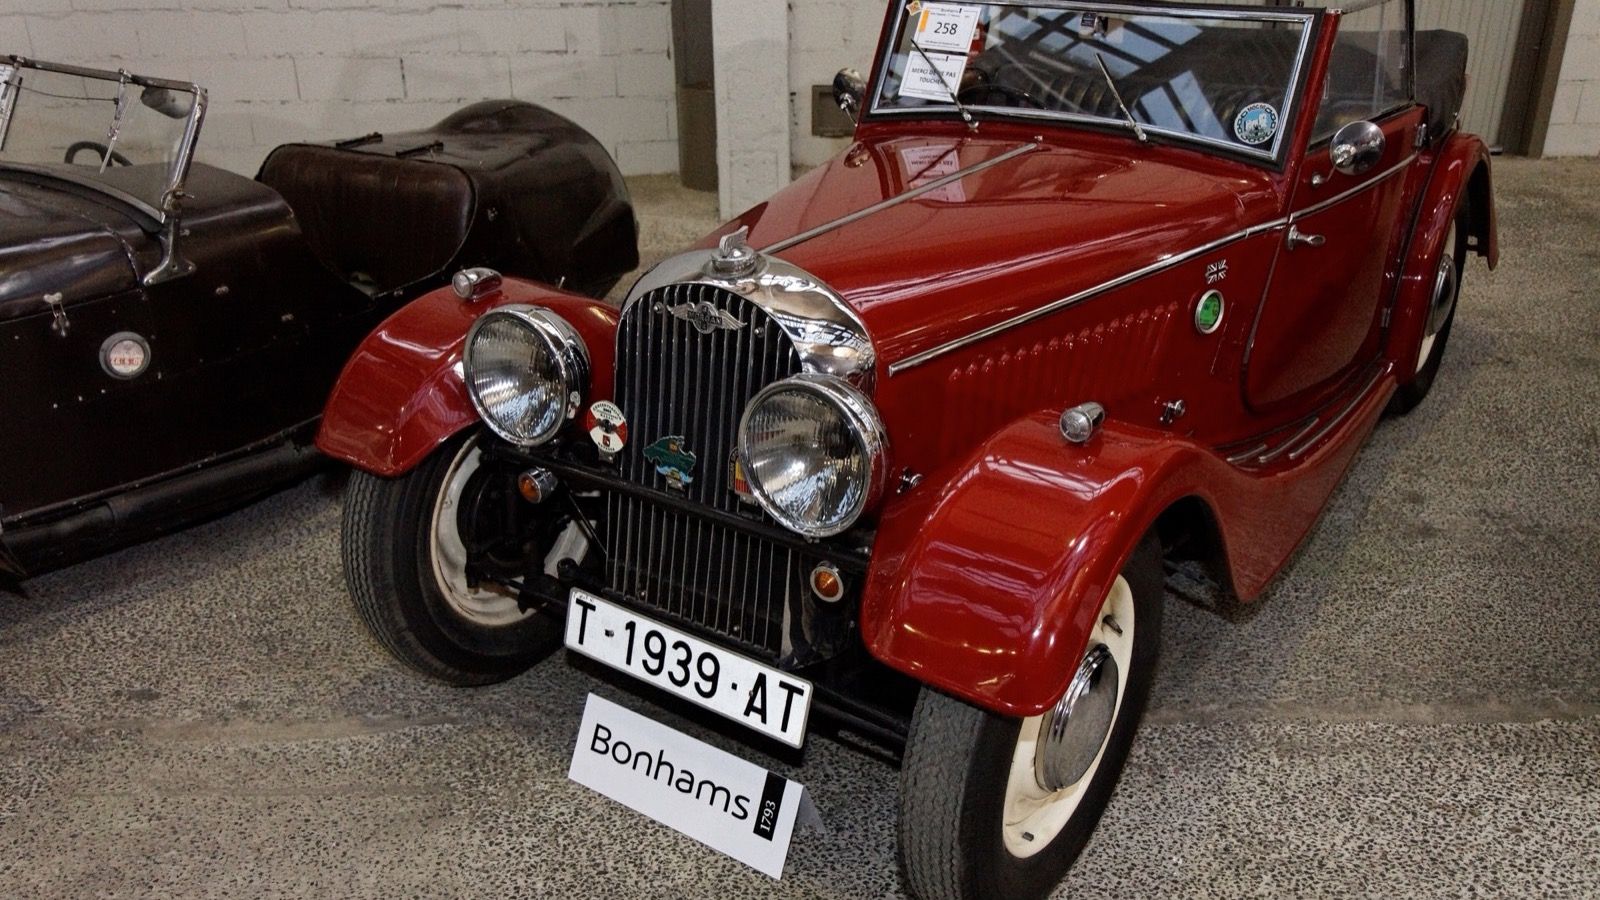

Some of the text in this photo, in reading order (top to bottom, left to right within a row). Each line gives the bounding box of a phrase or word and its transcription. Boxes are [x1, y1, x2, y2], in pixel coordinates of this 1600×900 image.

[934, 22, 958, 35] 258
[911, 67, 928, 75] MERCI
[590, 723, 751, 820] Bonhams
[759, 800, 776, 833] 1793
